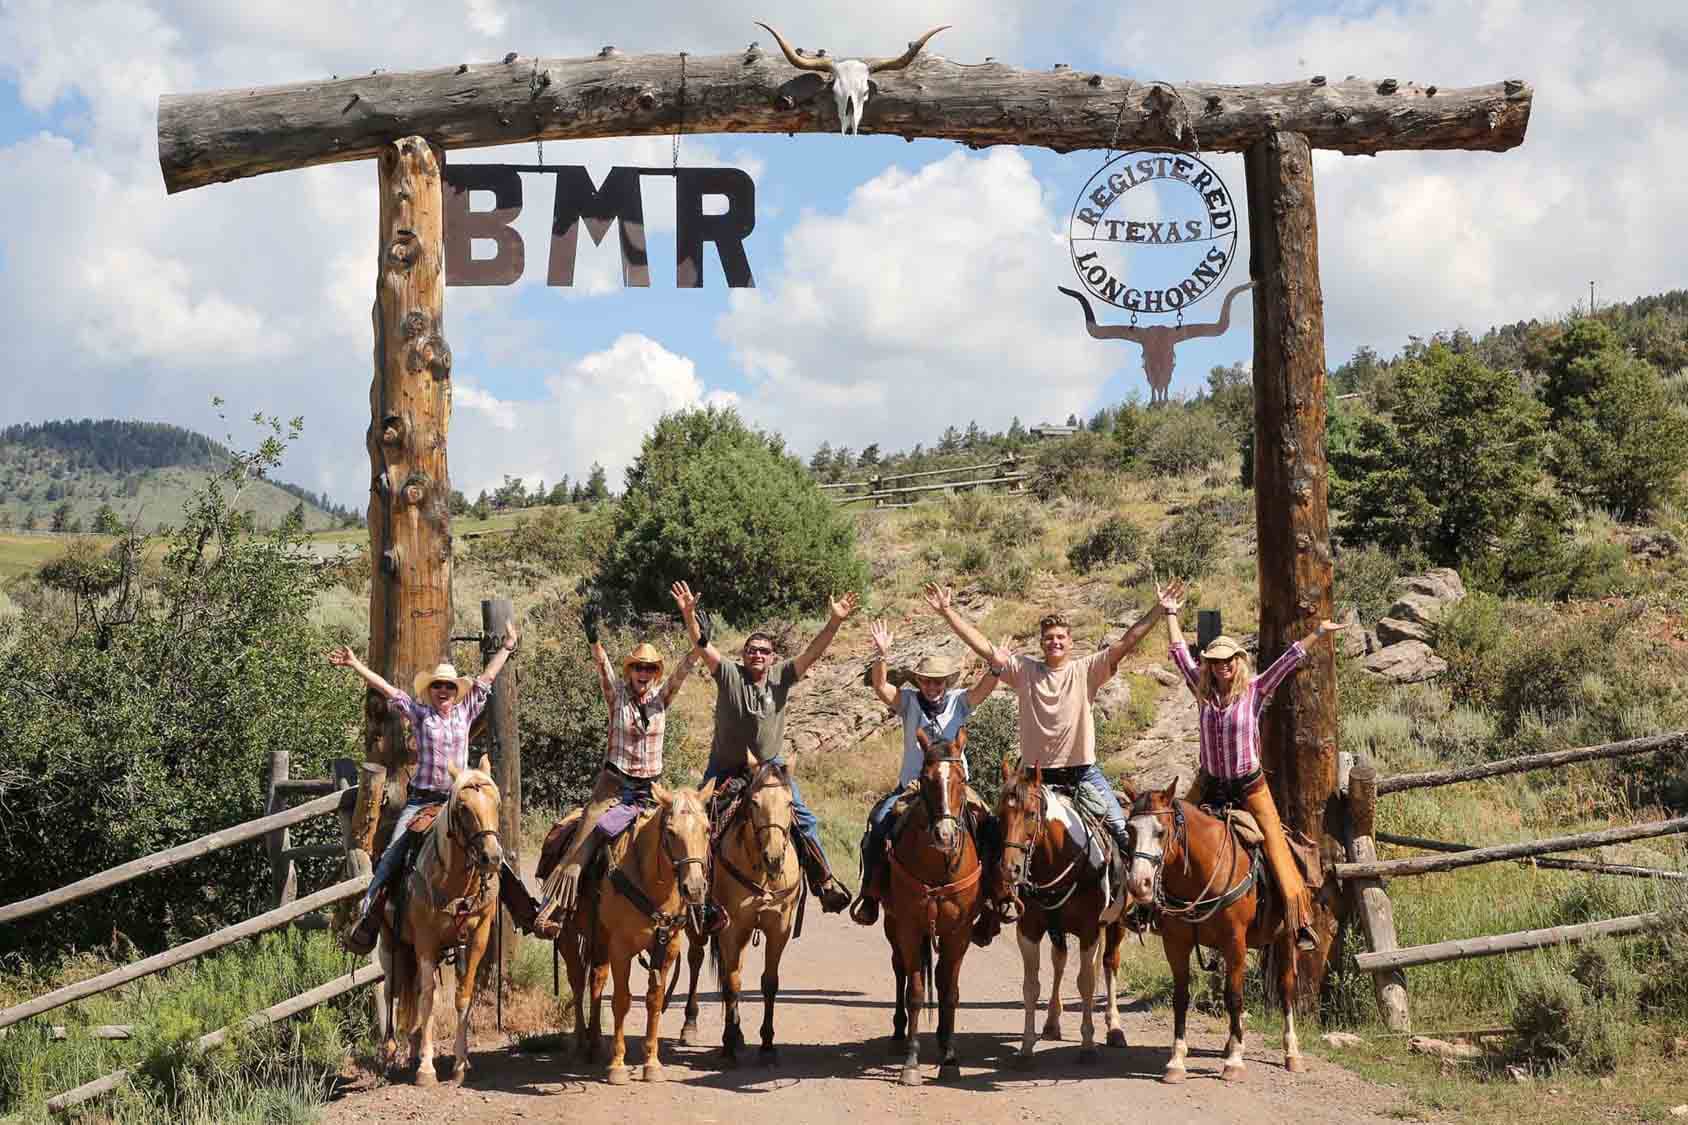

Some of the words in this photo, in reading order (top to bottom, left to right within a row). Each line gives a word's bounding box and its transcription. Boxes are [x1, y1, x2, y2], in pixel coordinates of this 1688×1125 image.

[442, 164, 756, 288] BMR
[1078, 157, 1232, 230] REGISTERED
[1105, 220, 1202, 243] TEXAS
[1076, 247, 1227, 311] LONGHORNS
